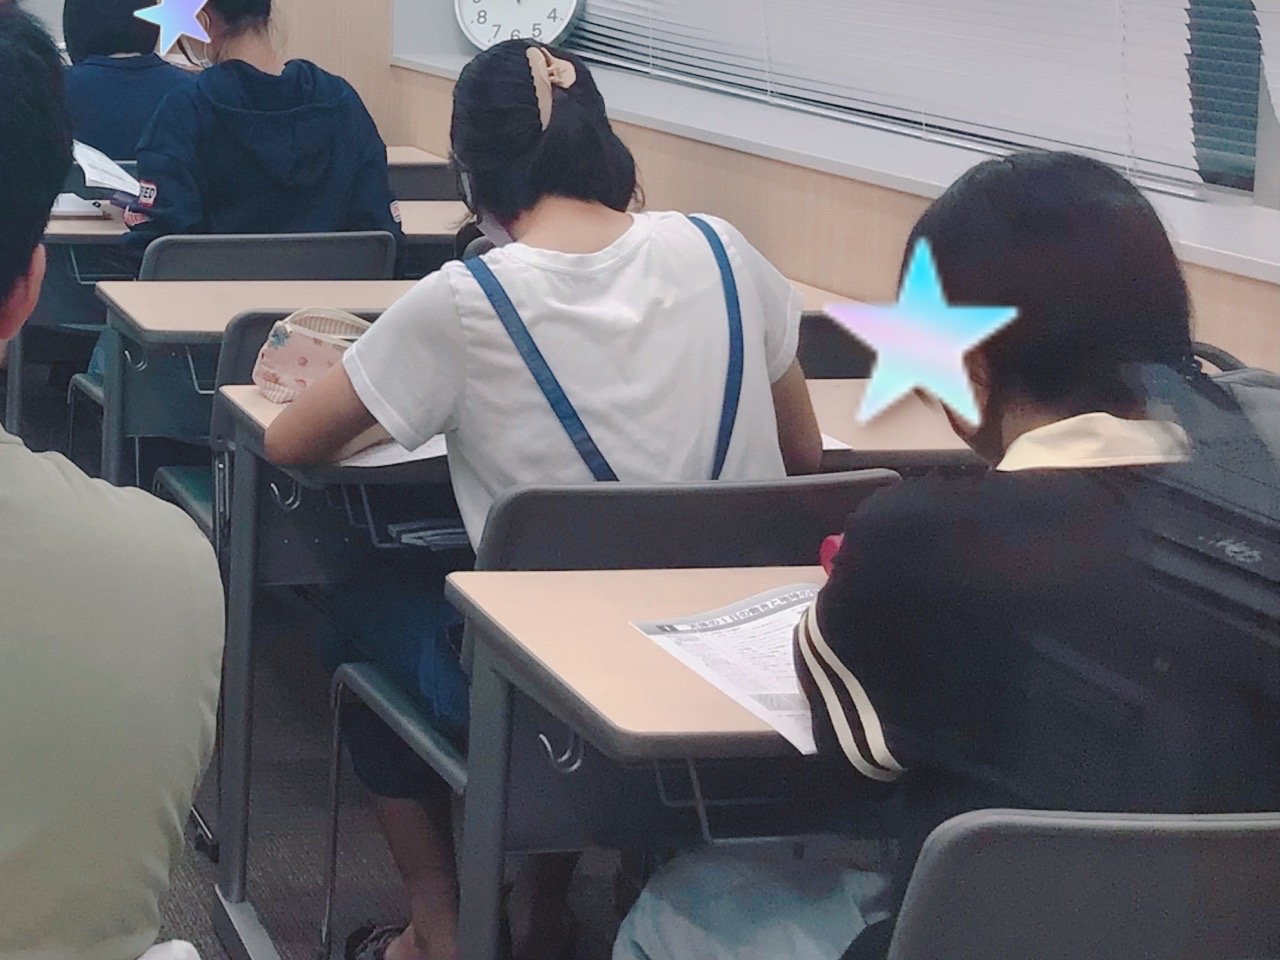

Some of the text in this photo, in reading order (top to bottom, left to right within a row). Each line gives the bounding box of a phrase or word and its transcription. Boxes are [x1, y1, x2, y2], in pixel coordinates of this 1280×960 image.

[476, 10, 487, 25] 8
[547, 8, 558, 22] 4
[492, 24, 501, 38] 7
[510, 29, 521, 40] 6
[531, 23, 542, 38] 5
